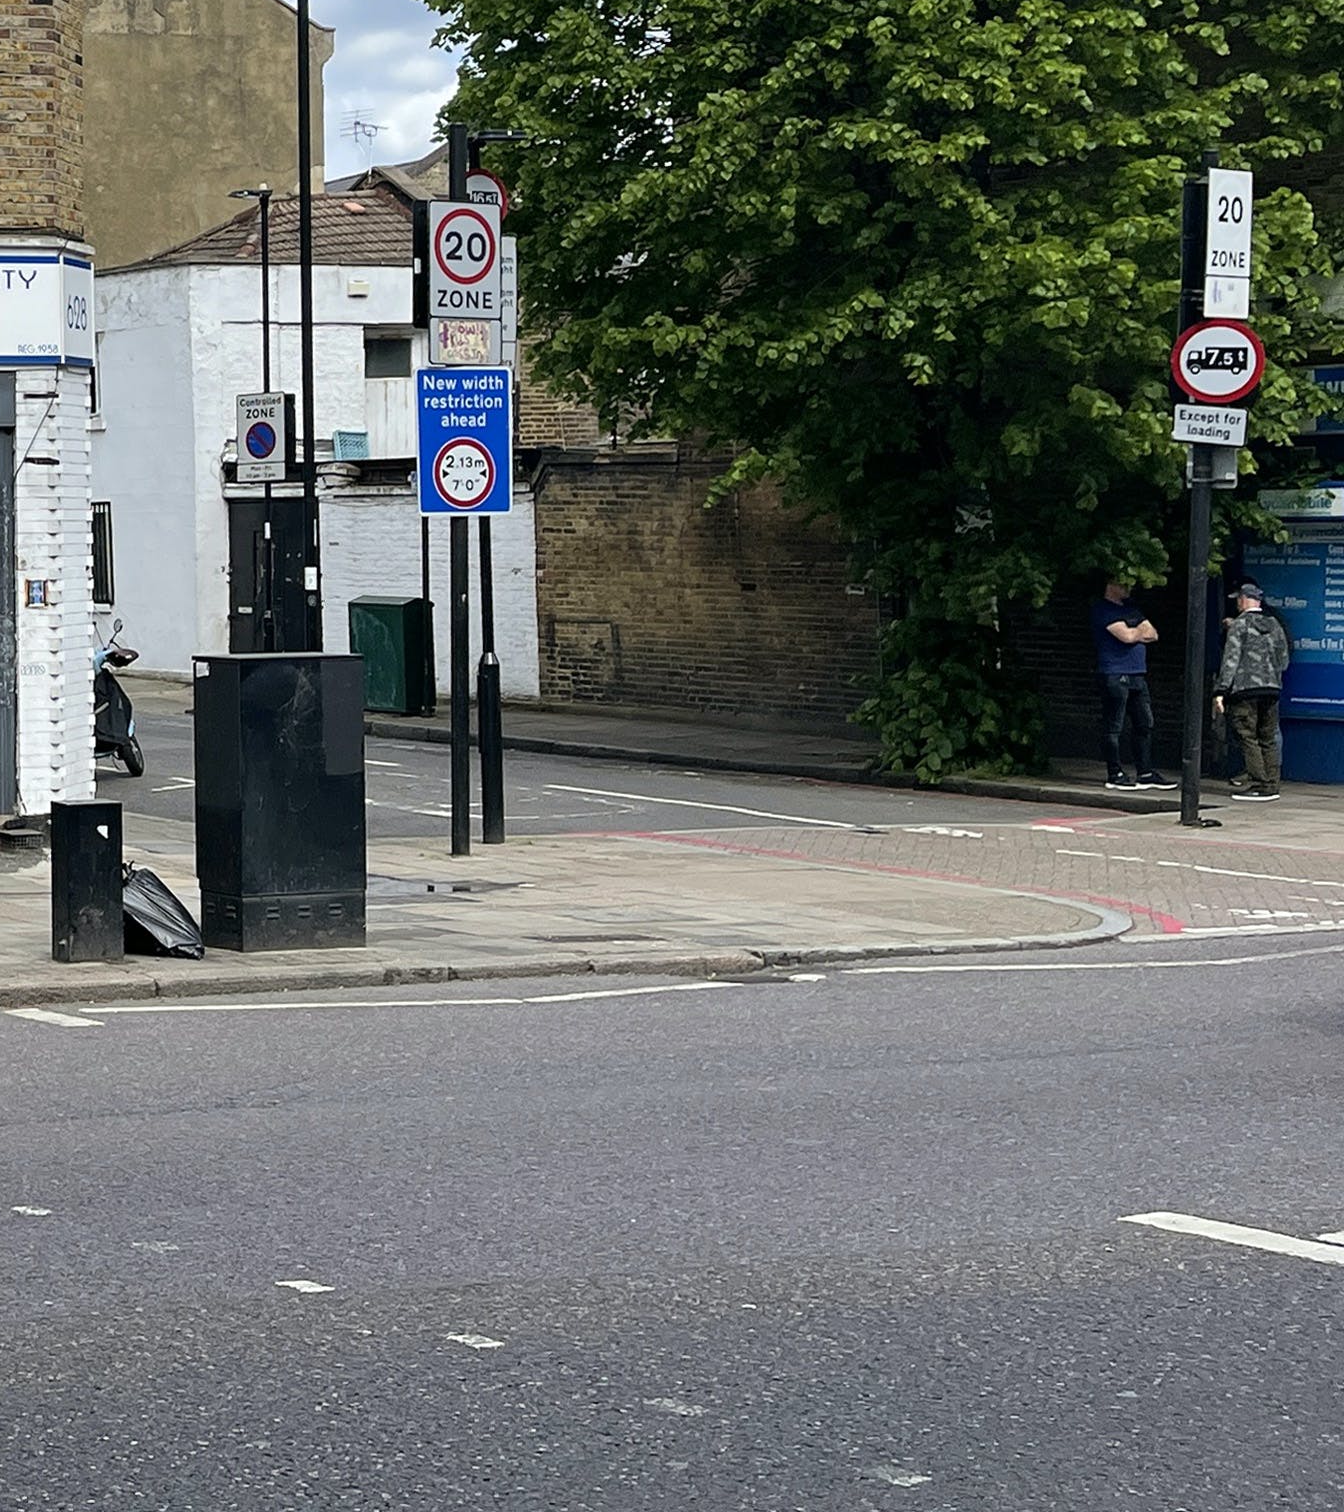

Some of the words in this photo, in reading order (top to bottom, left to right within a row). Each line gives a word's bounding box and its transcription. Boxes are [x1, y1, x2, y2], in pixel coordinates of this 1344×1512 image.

[1218, 196, 1243, 224] 20
[444, 231, 487, 262] 20
[1211, 250, 1245, 268] ZONE
[437, 289, 493, 309] ZONE
[67, 296, 87, 330] 628
[1207, 349, 1233, 365] 7.5
[423, 375, 457, 390] New
[462, 375, 503, 390] width
[240, 397, 282, 407] Controlled
[424, 394, 502, 408] restriction
[246, 408, 275, 419] ZONE
[441, 412, 486, 427] ahead
[1180, 409, 1219, 424] Except
[1224, 413, 1240, 425] for
[1187, 424, 1230, 440] loading
